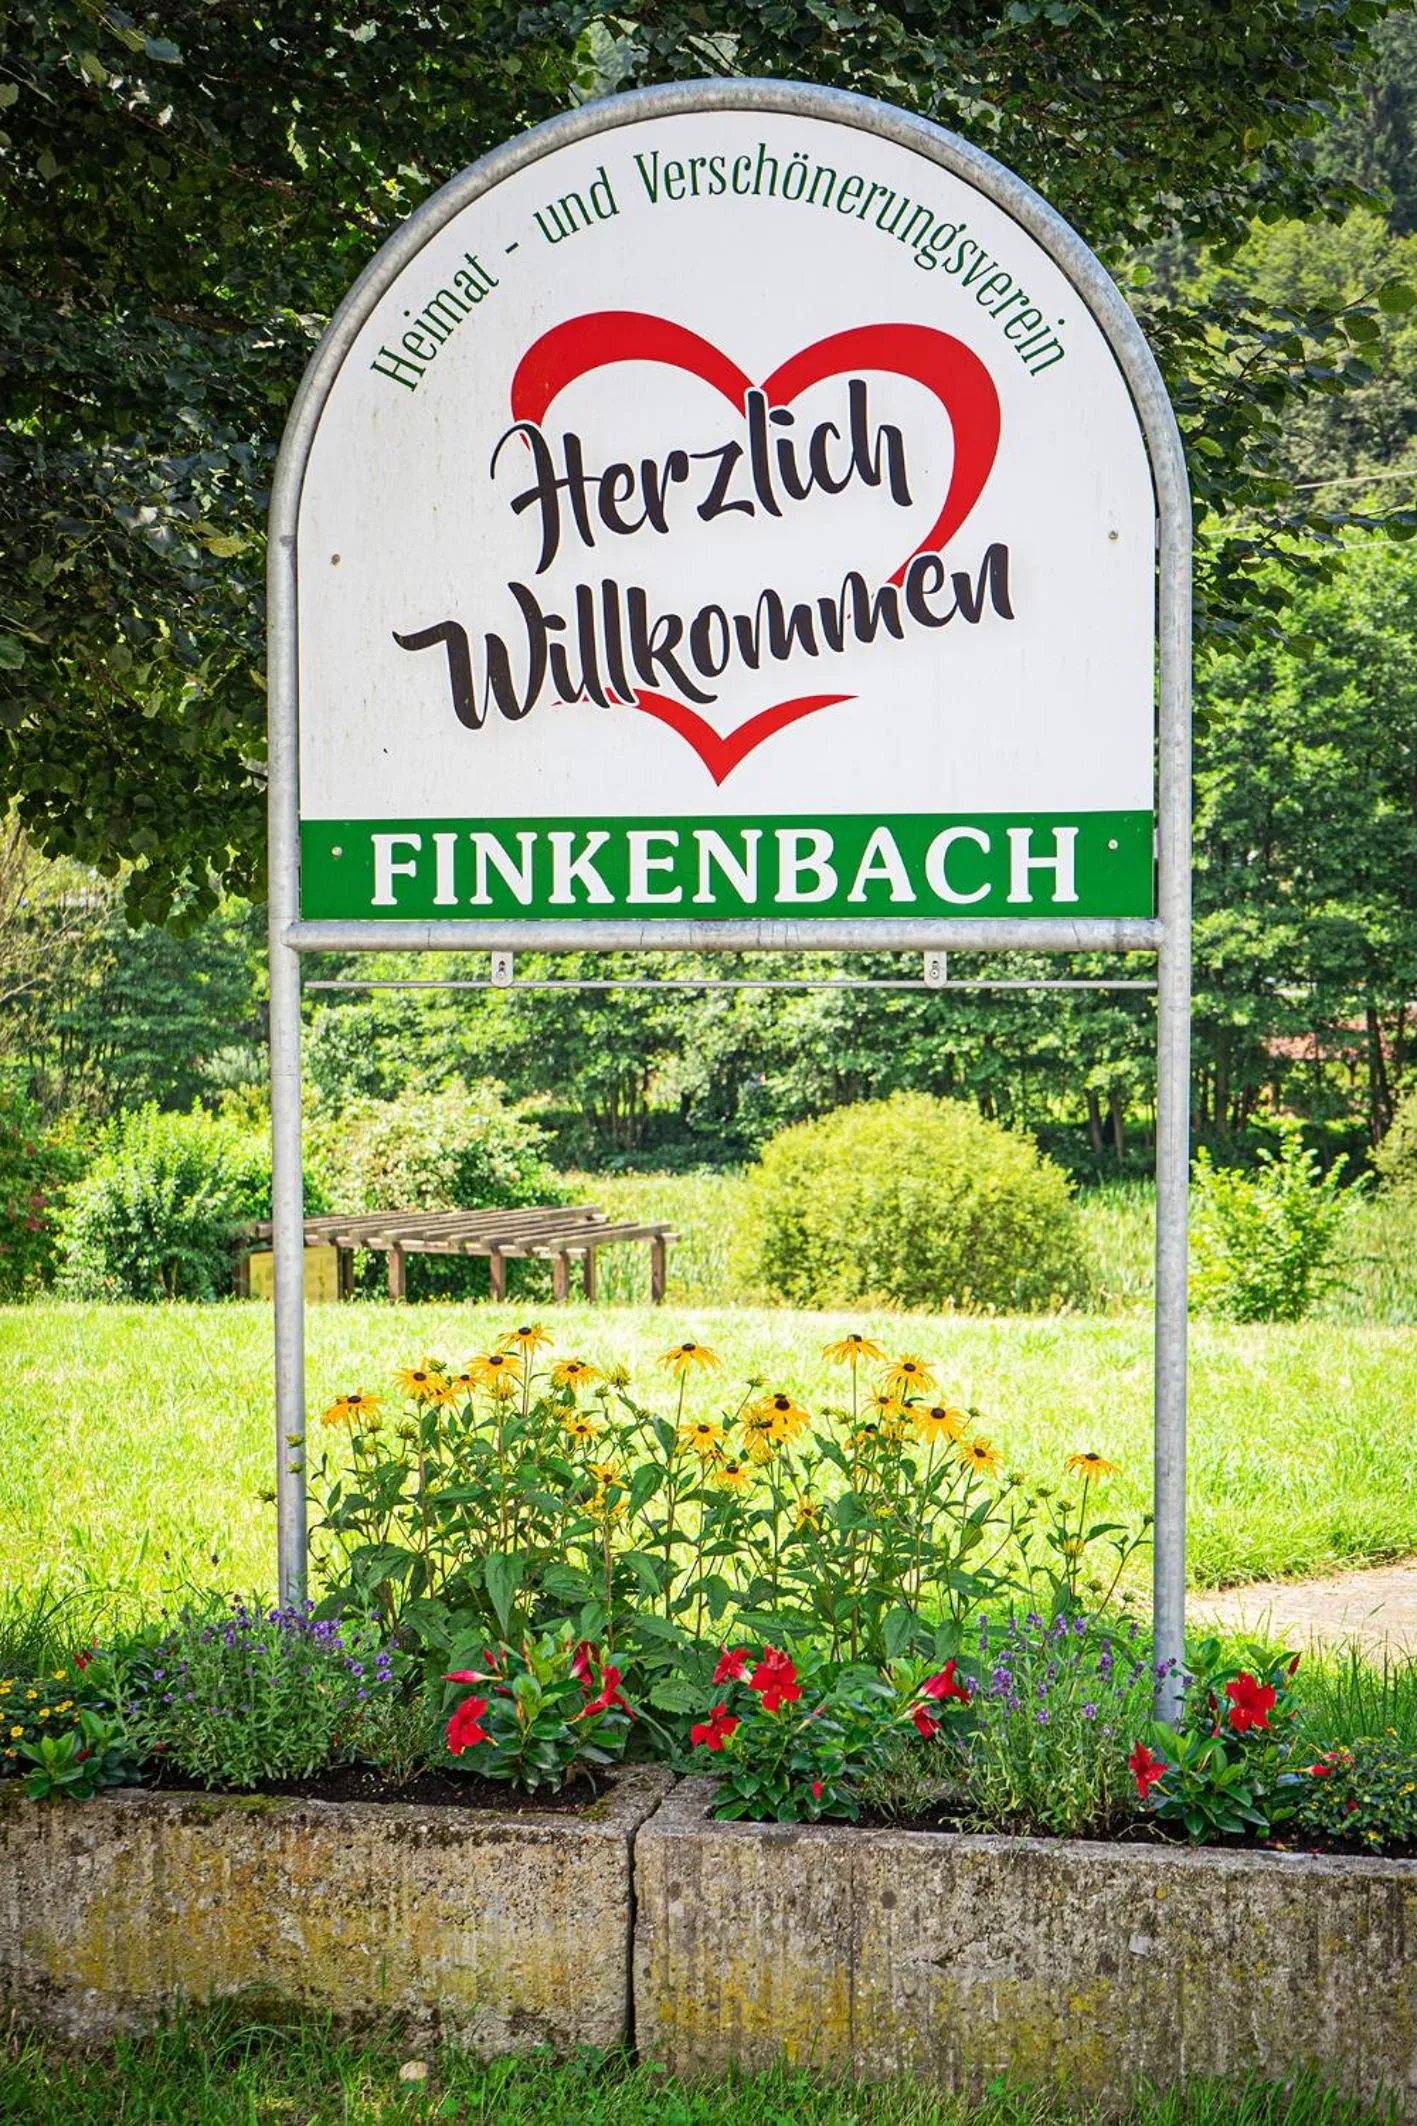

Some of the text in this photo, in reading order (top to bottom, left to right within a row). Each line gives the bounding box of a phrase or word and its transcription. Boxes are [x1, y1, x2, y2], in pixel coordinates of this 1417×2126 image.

[370, 252, 500, 393] Heimat
[532, 166, 620, 244] und
[632, 142, 1066, 377] Verschönerungsverein
[490, 379, 913, 575] Herzlich
[393, 543, 1015, 730] Willkommen
[370, 826, 1080, 906] FINKENBACH
